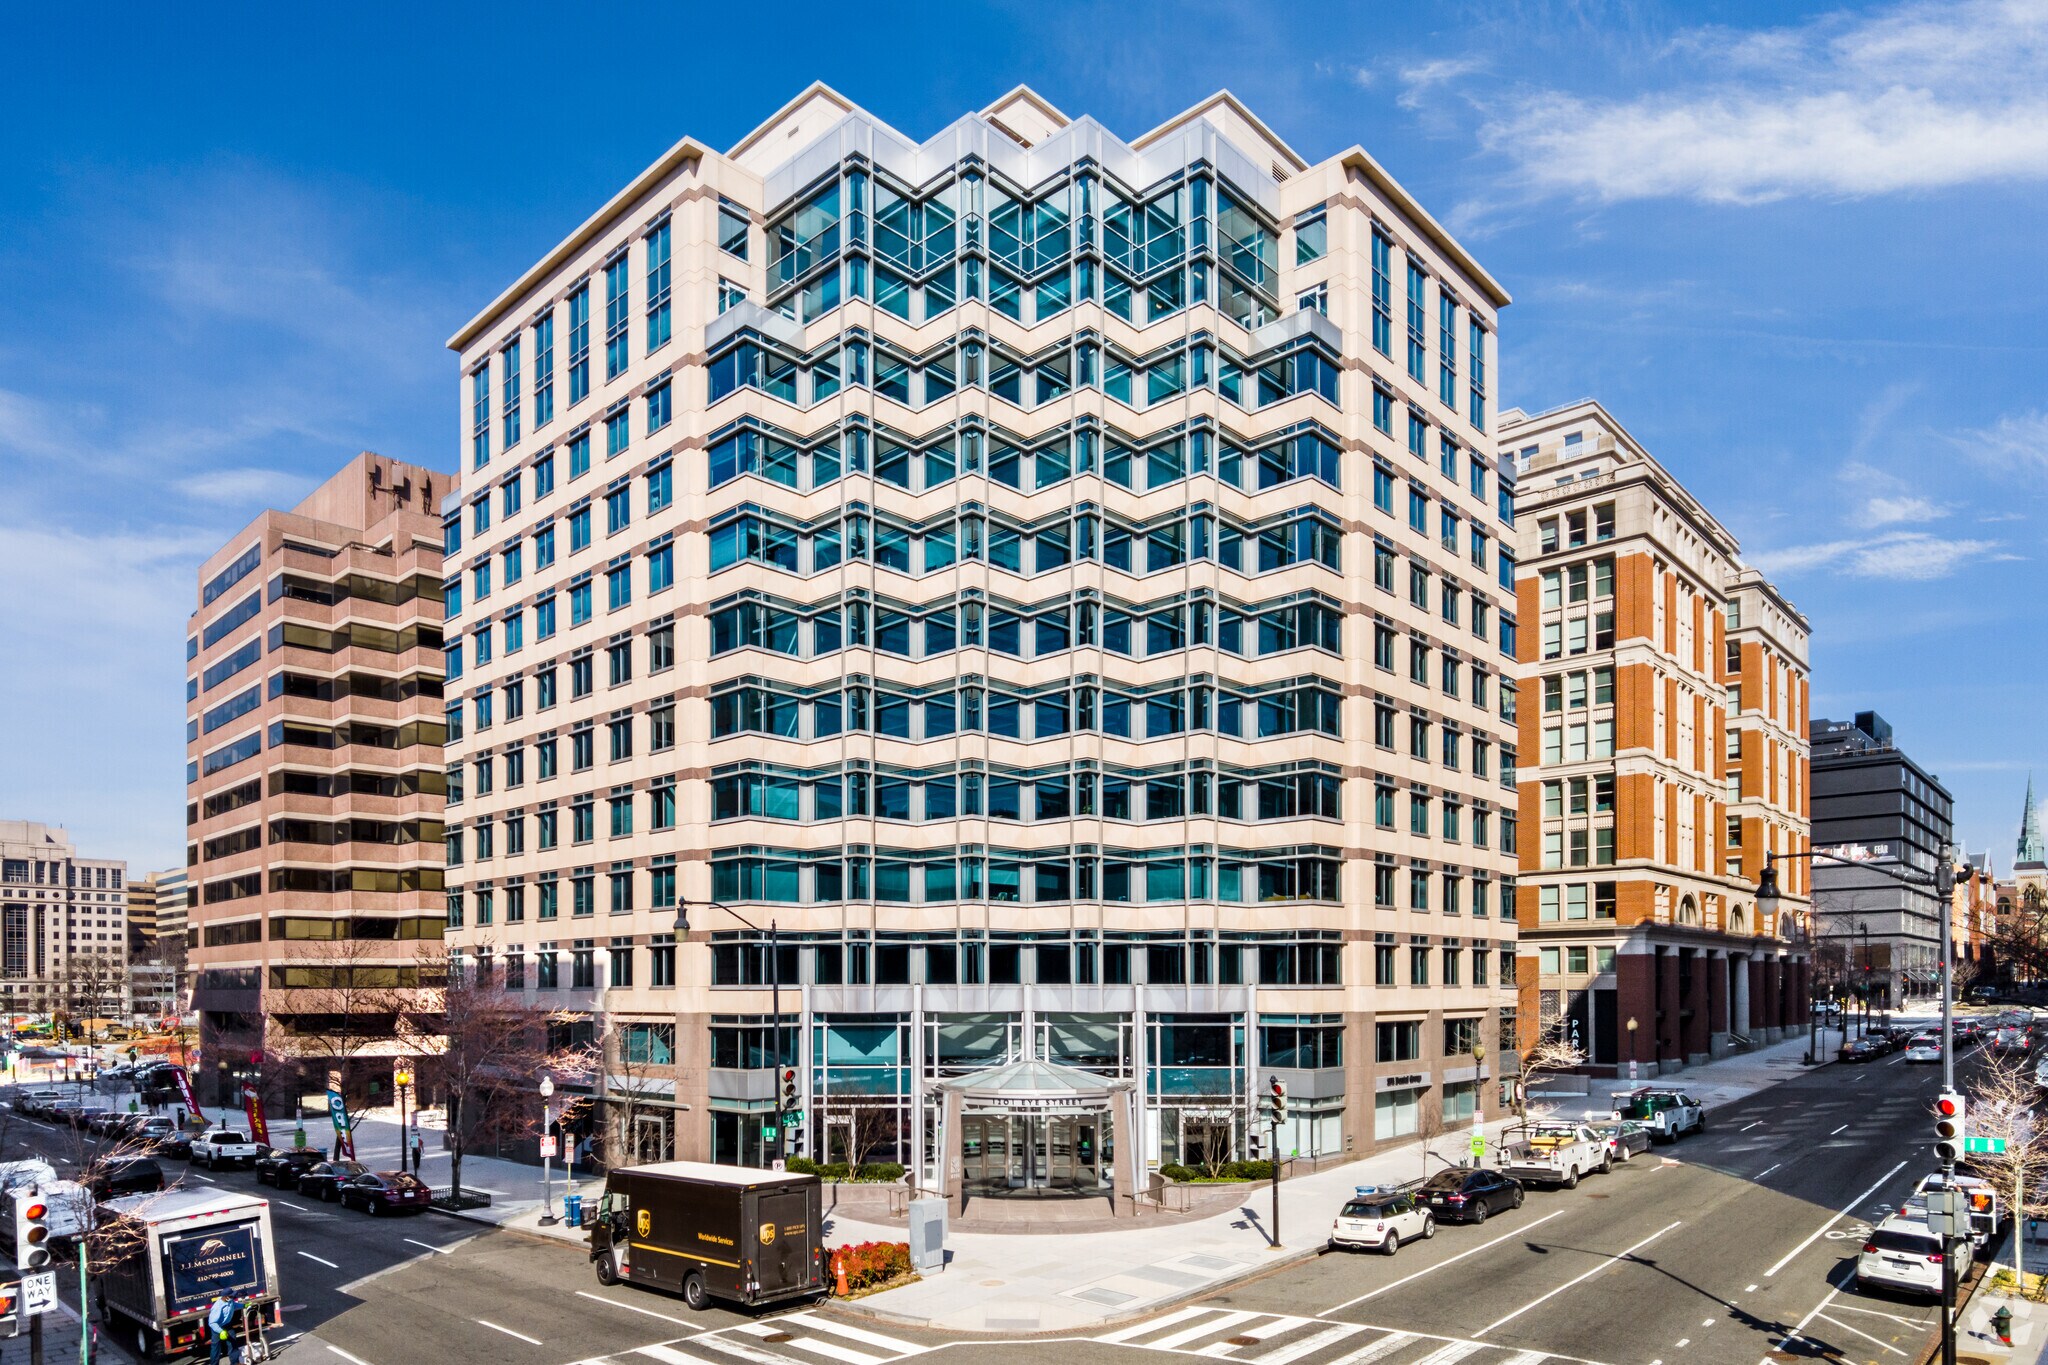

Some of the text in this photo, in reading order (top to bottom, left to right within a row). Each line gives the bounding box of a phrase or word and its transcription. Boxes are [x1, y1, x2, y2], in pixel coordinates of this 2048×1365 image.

[1021, 1098, 1040, 1106] EYE
[1045, 1098, 1084, 1106] STREET
[697, 1232, 734, 1246] Worldwide Services
[762, 1229, 775, 1242] ups
[26, 1275, 51, 1289] ONE
[27, 1286, 51, 1299] WAY
